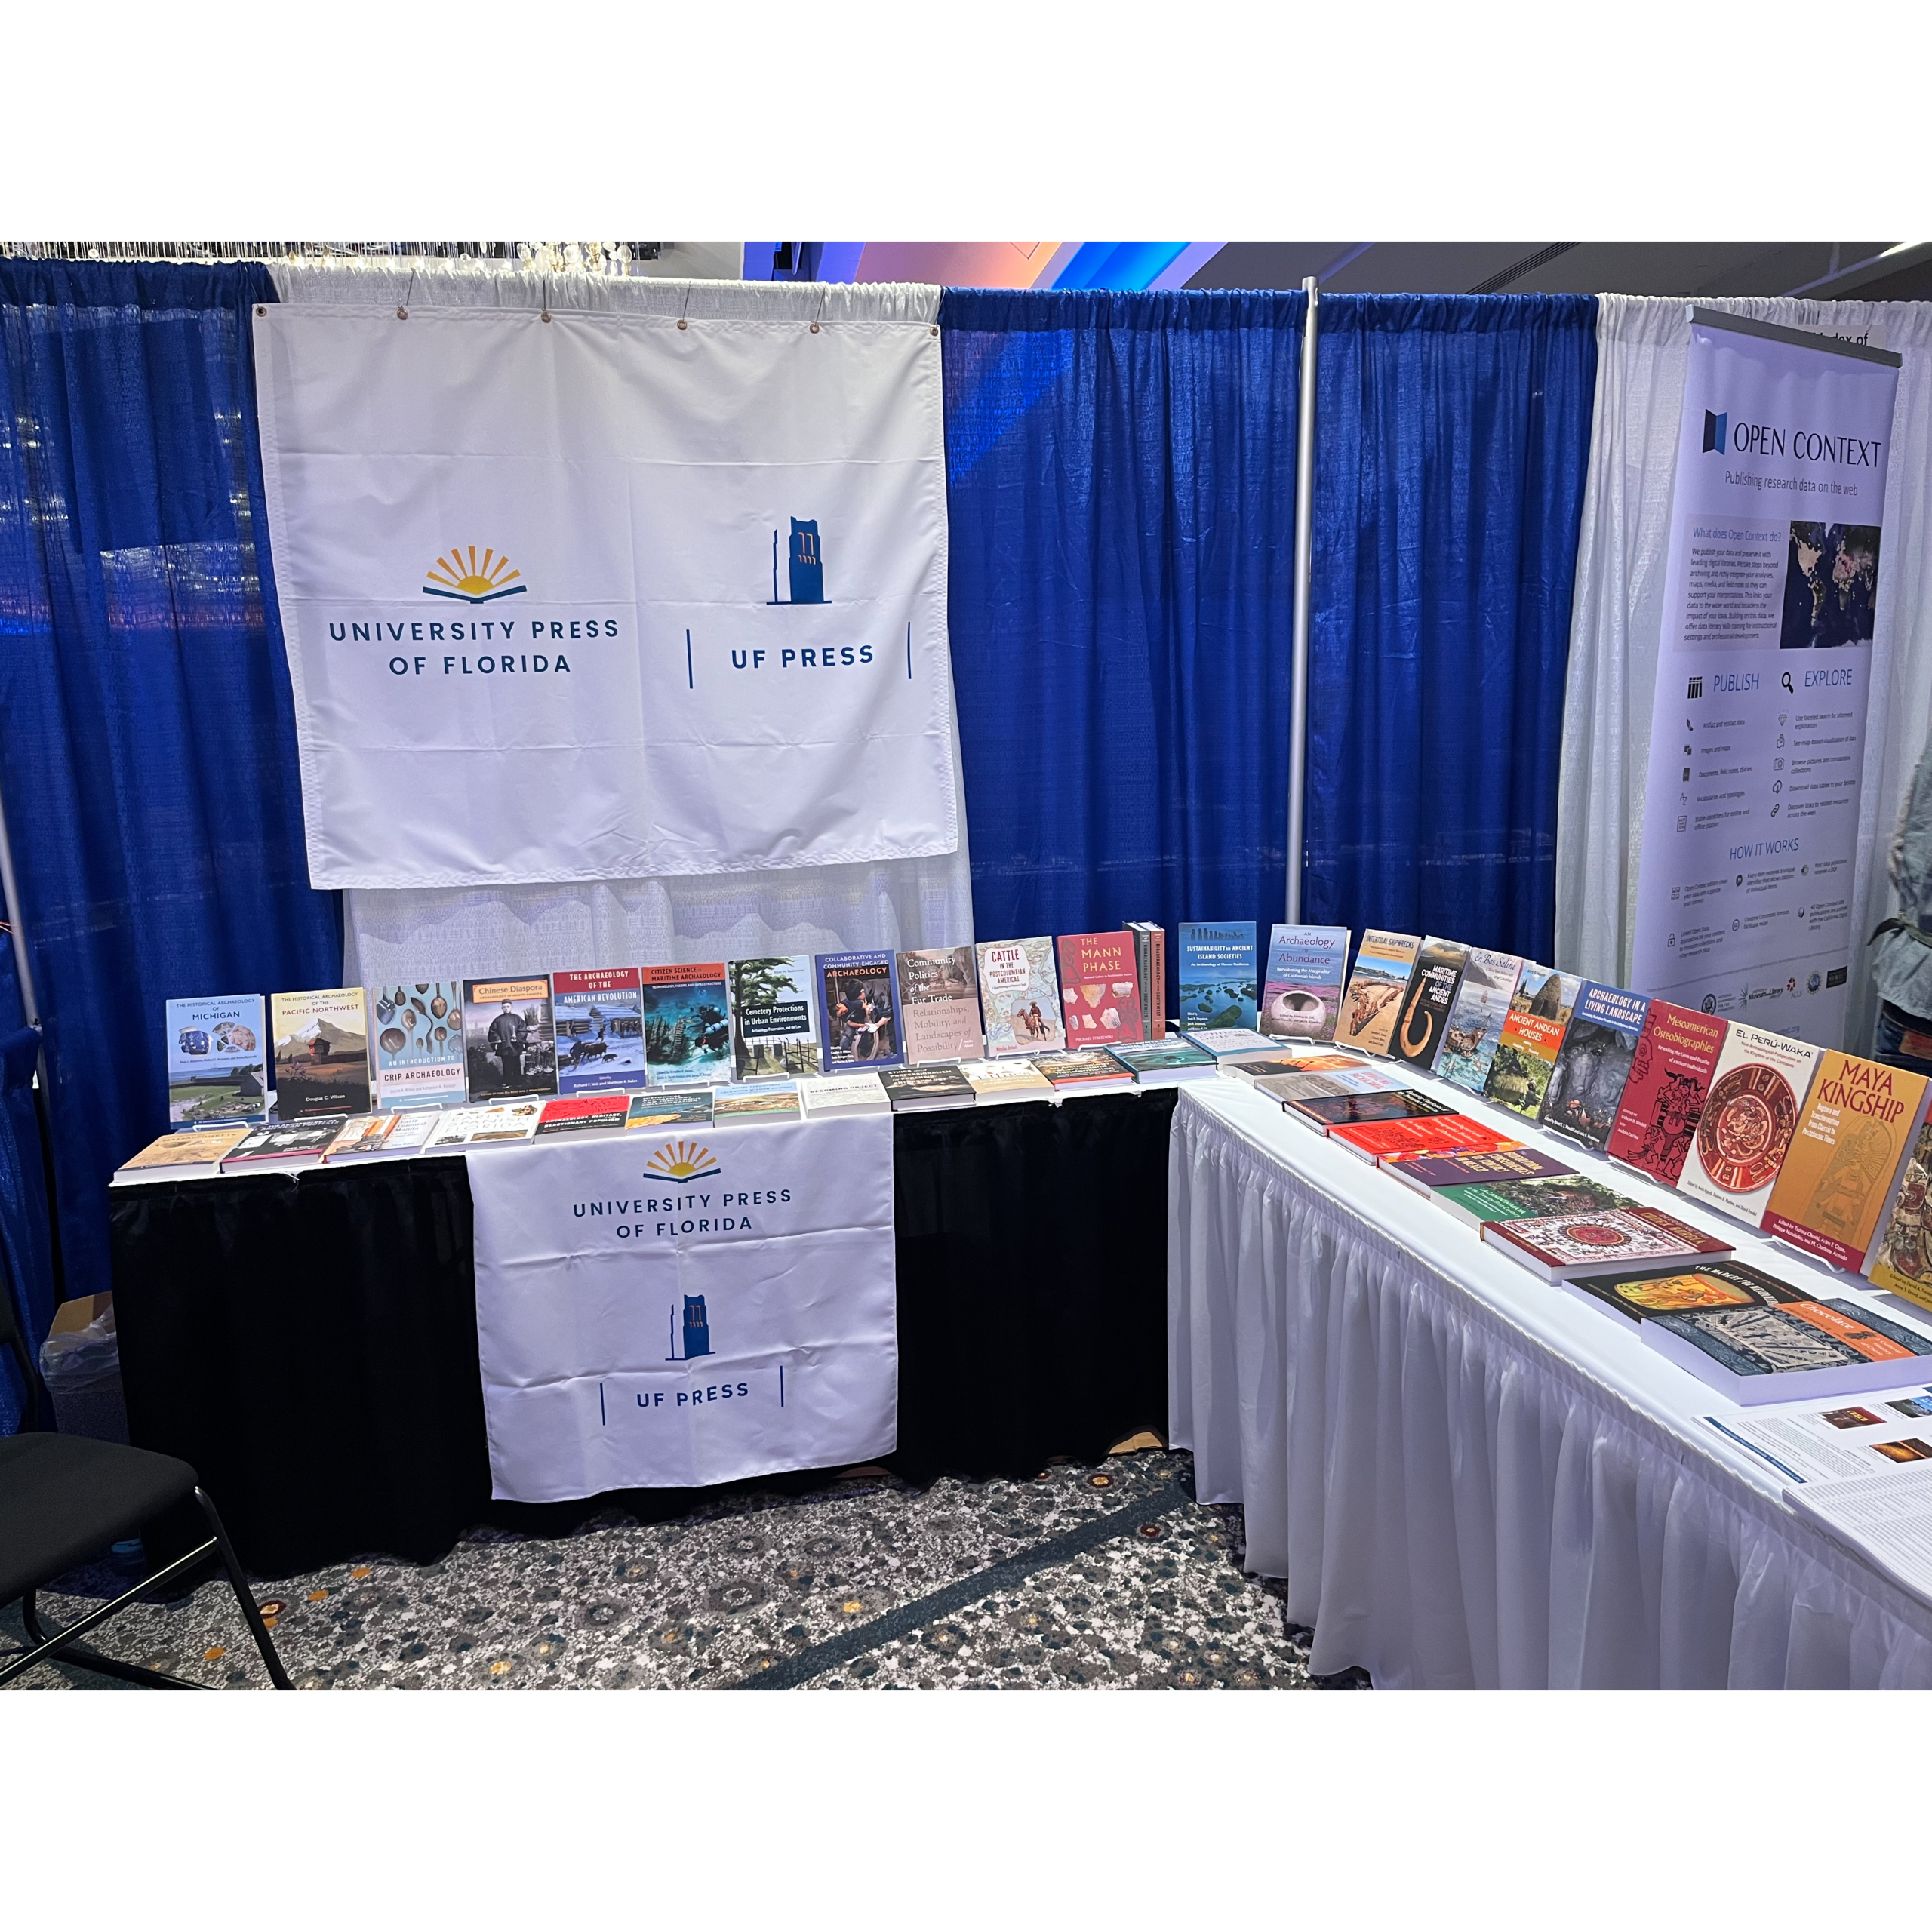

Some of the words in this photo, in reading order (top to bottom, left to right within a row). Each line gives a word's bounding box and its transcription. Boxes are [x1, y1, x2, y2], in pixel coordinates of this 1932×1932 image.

[1734, 423, 1785, 457] OPEN
[1794, 431, 1881, 467] CONTEXT
[1725, 471, 1762, 490] Publishing
[1764, 477, 1797, 490] research
[1799, 478, 1815, 491] data
[1818, 483, 1828, 492] on
[1831, 481, 1841, 494] the
[1844, 484, 1858, 496] web
[1694, 528, 1711, 538] What
[1713, 528, 1727, 539] does
[1729, 529, 1743, 542] Open
[1745, 531, 1767, 541] Context
[1770, 531, 1781, 541] do?
[330, 621, 515, 641] UNIVERSITY
[532, 619, 619, 639] PRESS
[731, 648, 765, 669] UF
[782, 645, 874, 668] PRESS
[389, 656, 427, 675] OF
[444, 654, 571, 675] FLORIDA
[1713, 674, 1759, 692] PUBLISH
[1805, 669, 1852, 687] EXPLORE
[1730, 844, 1753, 860] HOW
[1755, 844, 1764, 856] IT
[1766, 838, 1798, 854] WORKS
[1081, 937, 1097, 946] THE
[1279, 936, 1335, 949] Archaeology
[1367, 935, 1388, 945] INTERTIDAL
[1389, 938, 1414, 949] SHIPWRECKS
[992, 949, 1019, 962] CATTLE
[1081, 947, 1121, 958] MANN
[1279, 953, 1330, 964] Abundance
[823, 960, 889, 969] COMMUNITY-ENGAGED
[907, 958, 956, 967] Community
[1083, 961, 1121, 972] PHASE
[1475, 952, 1482, 962] En
[1482, 954, 1496, 964] Bas
[1496, 957, 1516, 970] Saline
[584, 971, 629, 980] ARCHAEOLOGY
[827, 967, 887, 977] ARCHAEOLOGY
[909, 971, 938, 980] Politics
[990, 968, 1026, 977] POSTCOLUMBIAN
[1422, 969, 1455, 984] COMMUNITIES
[1433, 965, 1457, 977] MARITIME
[910, 983, 918, 994] of
[919, 983, 930, 992] the
[1429, 986, 1451, 997] ANCIENT
[1442, 983, 1453, 991] THE
[564, 995, 595, 1004] AMERICAN
[598, 992, 637, 1001] REVOLUTION
[928, 994, 952, 1003] Trade
[1431, 995, 1448, 1004] ANDES
[1589, 989, 1632, 1008] ARCHAEOLOGY
[1632, 1000, 1641, 1011] IN
[1640, 1002, 1646, 1012] A
[312, 1004, 359, 1013] NORTHWEST
[773, 1004, 804, 1013] Protections
[912, 1005, 969, 1017] Relationships,
[1585, 999, 1605, 1014] LIVING
[1605, 1005, 1642, 1024] LANDSCAPE
[192, 1011, 240, 1020] MICHIGAN
[770, 1014, 807, 1023] Environments
[914, 1020, 951, 1029] Mobility,
[1509, 1013, 1534, 1027] ANCIENT
[1534, 1022, 1560, 1035] ANDEAN
[1667, 1014, 1718, 1038] Mesoamerican
[915, 1030, 961, 1041] Landscapes
[964, 1027, 971, 1038] of
[1518, 1027, 1543, 1041] HOUSES
[1654, 1026, 1714, 1053] Osteobiographies
[1736, 1029, 1748, 1039] EL
[917, 1041, 958, 1052] Possibility
[399, 1056, 445, 1065] INTRODUCTION
[1658, 1045, 1675, 1055] Revealing
[1697, 1057, 1709, 1065] Deaths
[384, 1073, 402, 1081] CRIP
[405, 1068, 460, 1079] ARCHAEOLOGY
[1687, 1063, 1707, 1074] Individuals
[1839, 1060, 1892, 1096] MAYA
[1817, 1078, 1904, 1123] KINGSHIP
[447, 1117, 529, 1128] SPANISH
[452, 1114, 503, 1122] EARLY
[446, 1123, 525, 1133] FLORIDA
[573, 1194, 712, 1218] UNIVERSITY
[723, 1189, 792, 1207] PRESS
[616, 1224, 644, 1238] OF
[657, 1216, 752, 1236] FLORIDA
[1710, 1269, 1743, 1281] MARKET
[1800, 1303, 1854, 1329] Chocolate
[636, 1392, 665, 1408] UF
[676, 1382, 749, 1407] PRESS
